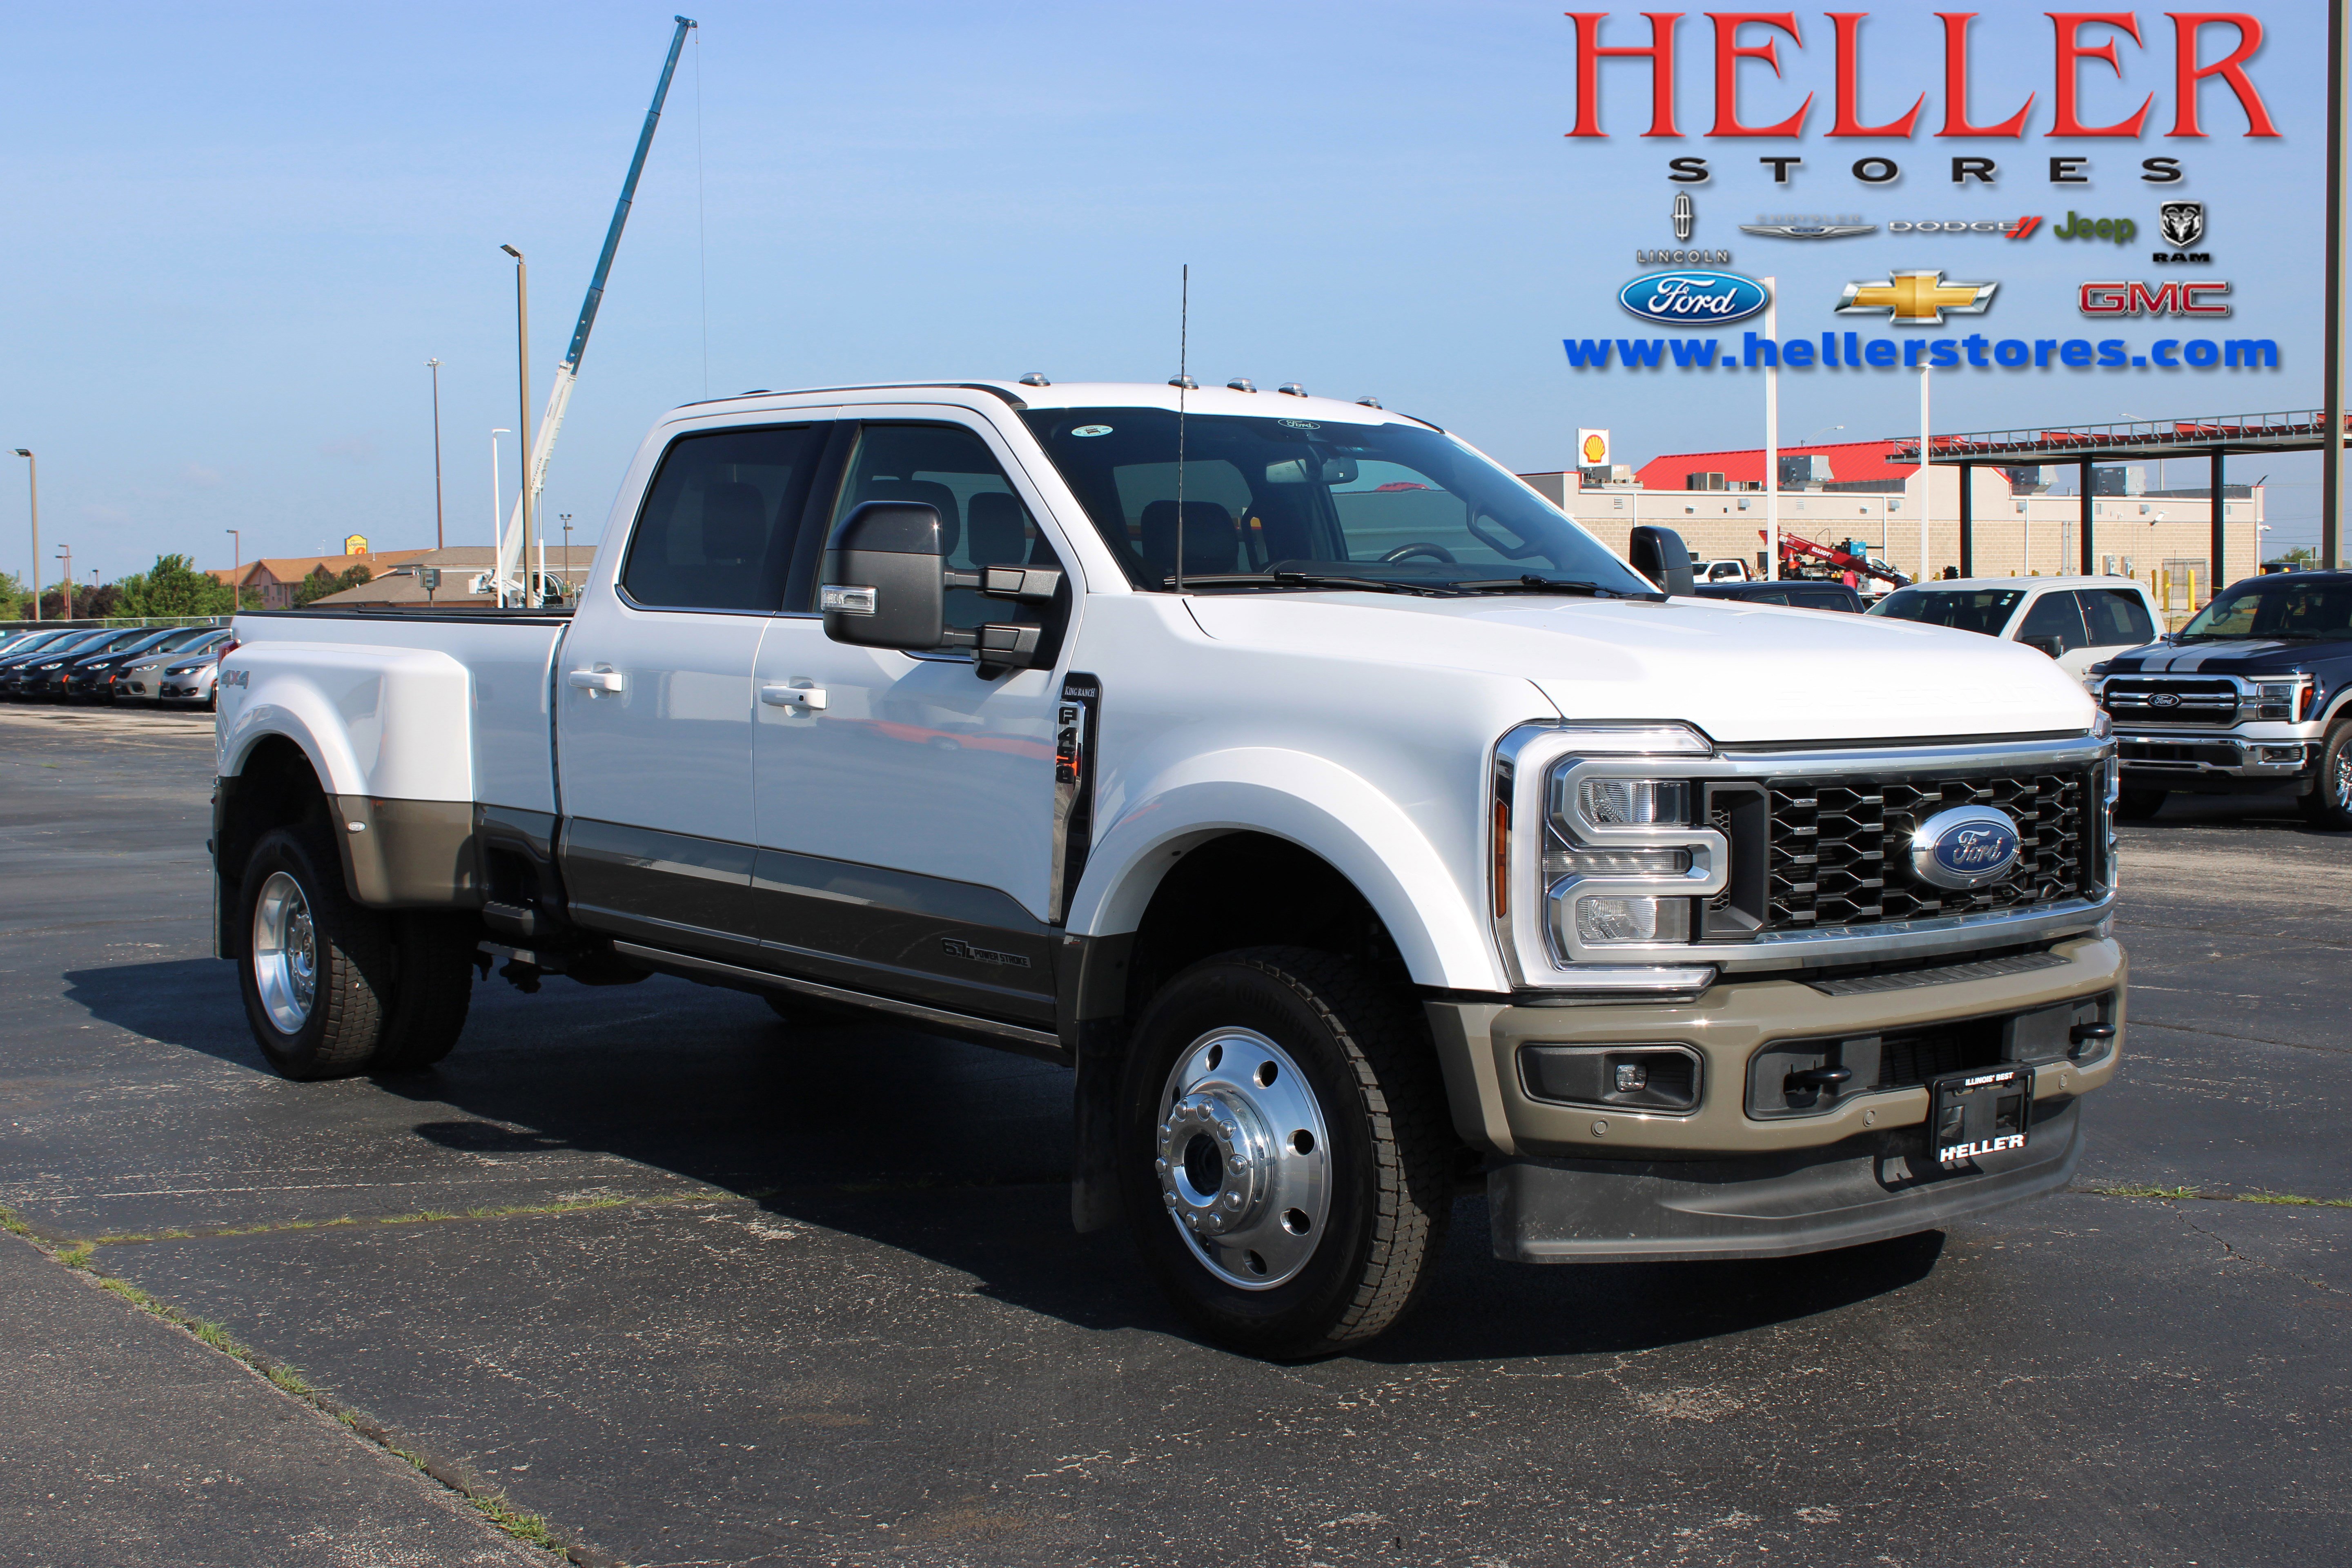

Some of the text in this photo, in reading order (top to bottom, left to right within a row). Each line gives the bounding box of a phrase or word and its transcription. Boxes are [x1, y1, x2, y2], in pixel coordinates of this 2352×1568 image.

[1286, 420, 1314, 428] Ford
[1811, 546, 1834, 558] ELLIOTT
[1065, 686, 1096, 697] KING RANCH
[2154, 695, 2173, 704] Ford
[1953, 830, 2002, 864] Ford
[974, 949, 999, 962] POWER
[999, 953, 1028, 967] STROKE
[1996, 1071, 2014, 1081] BEST
[1940, 1134, 2025, 1163] HELLER
